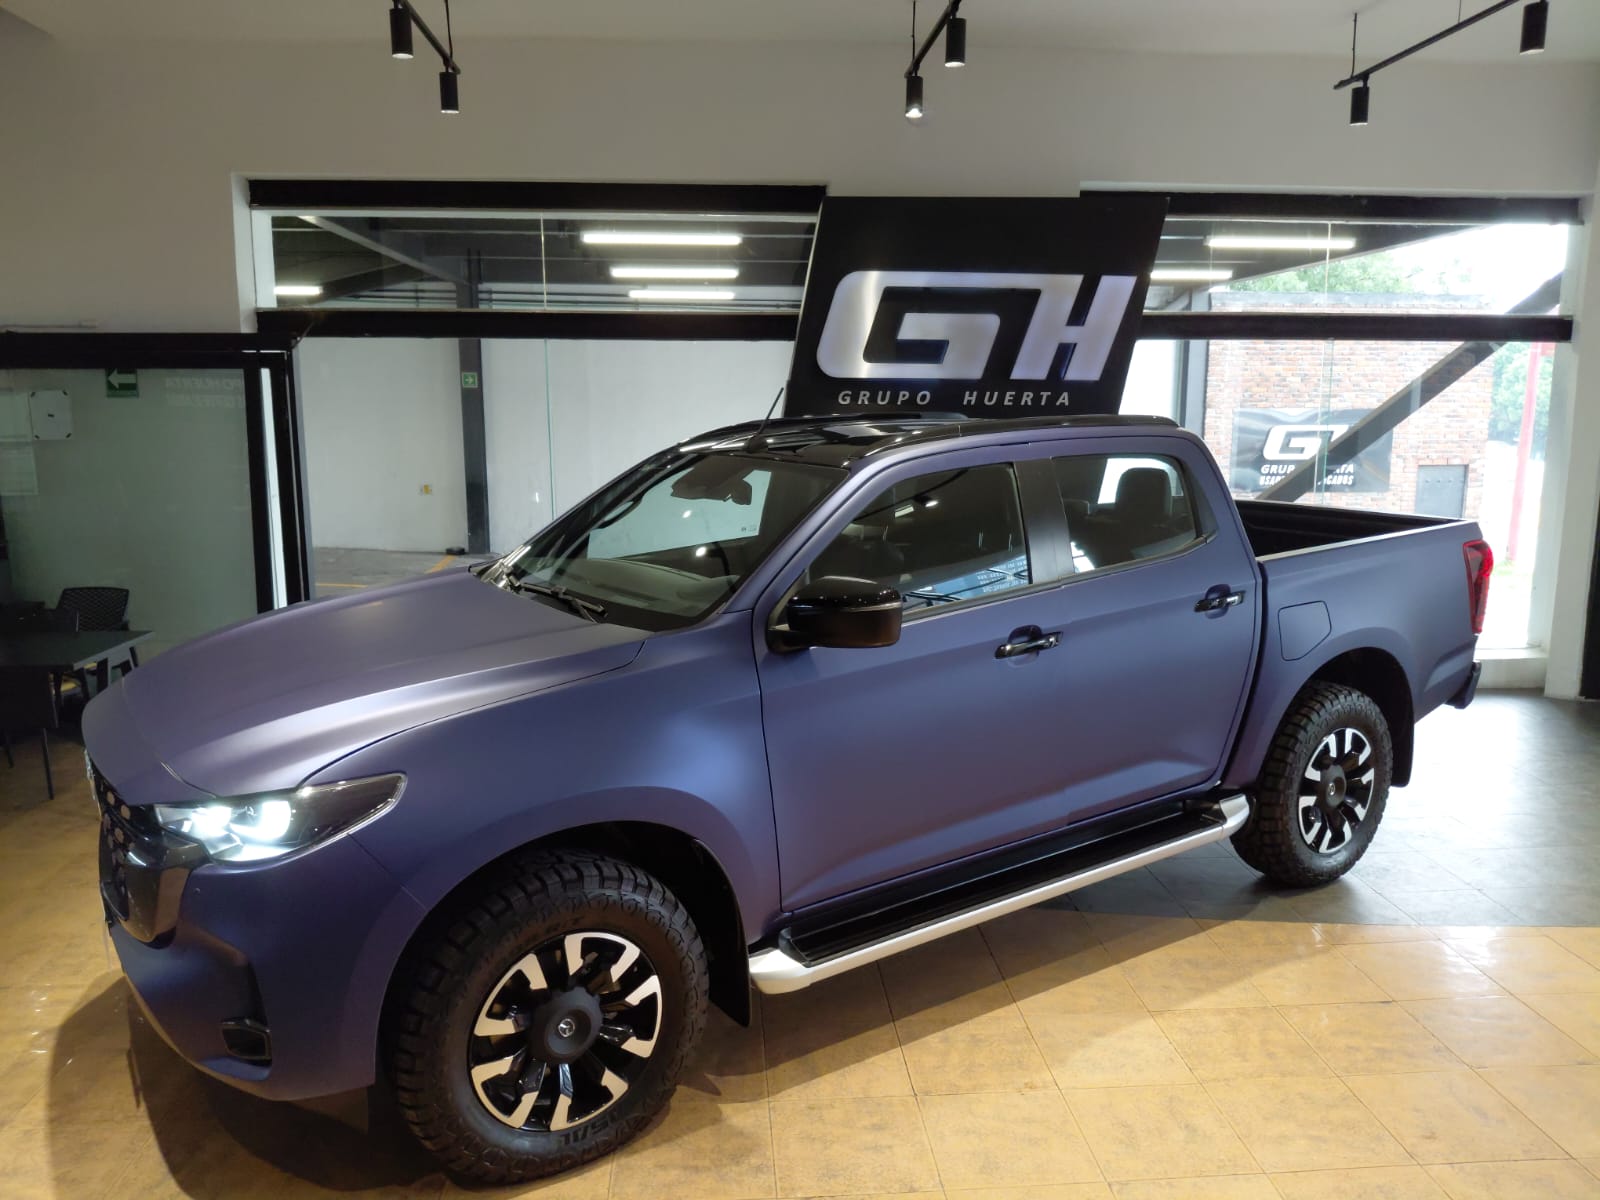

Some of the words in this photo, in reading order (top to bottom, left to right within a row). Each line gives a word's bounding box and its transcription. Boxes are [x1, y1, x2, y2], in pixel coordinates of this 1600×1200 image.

[816, 270, 1138, 381] GH
[838, 390, 932, 406] GRUPO
[963, 390, 1071, 407] HUERTA
[1263, 424, 1349, 460] G
[1260, 464, 1295, 474] GRUP
